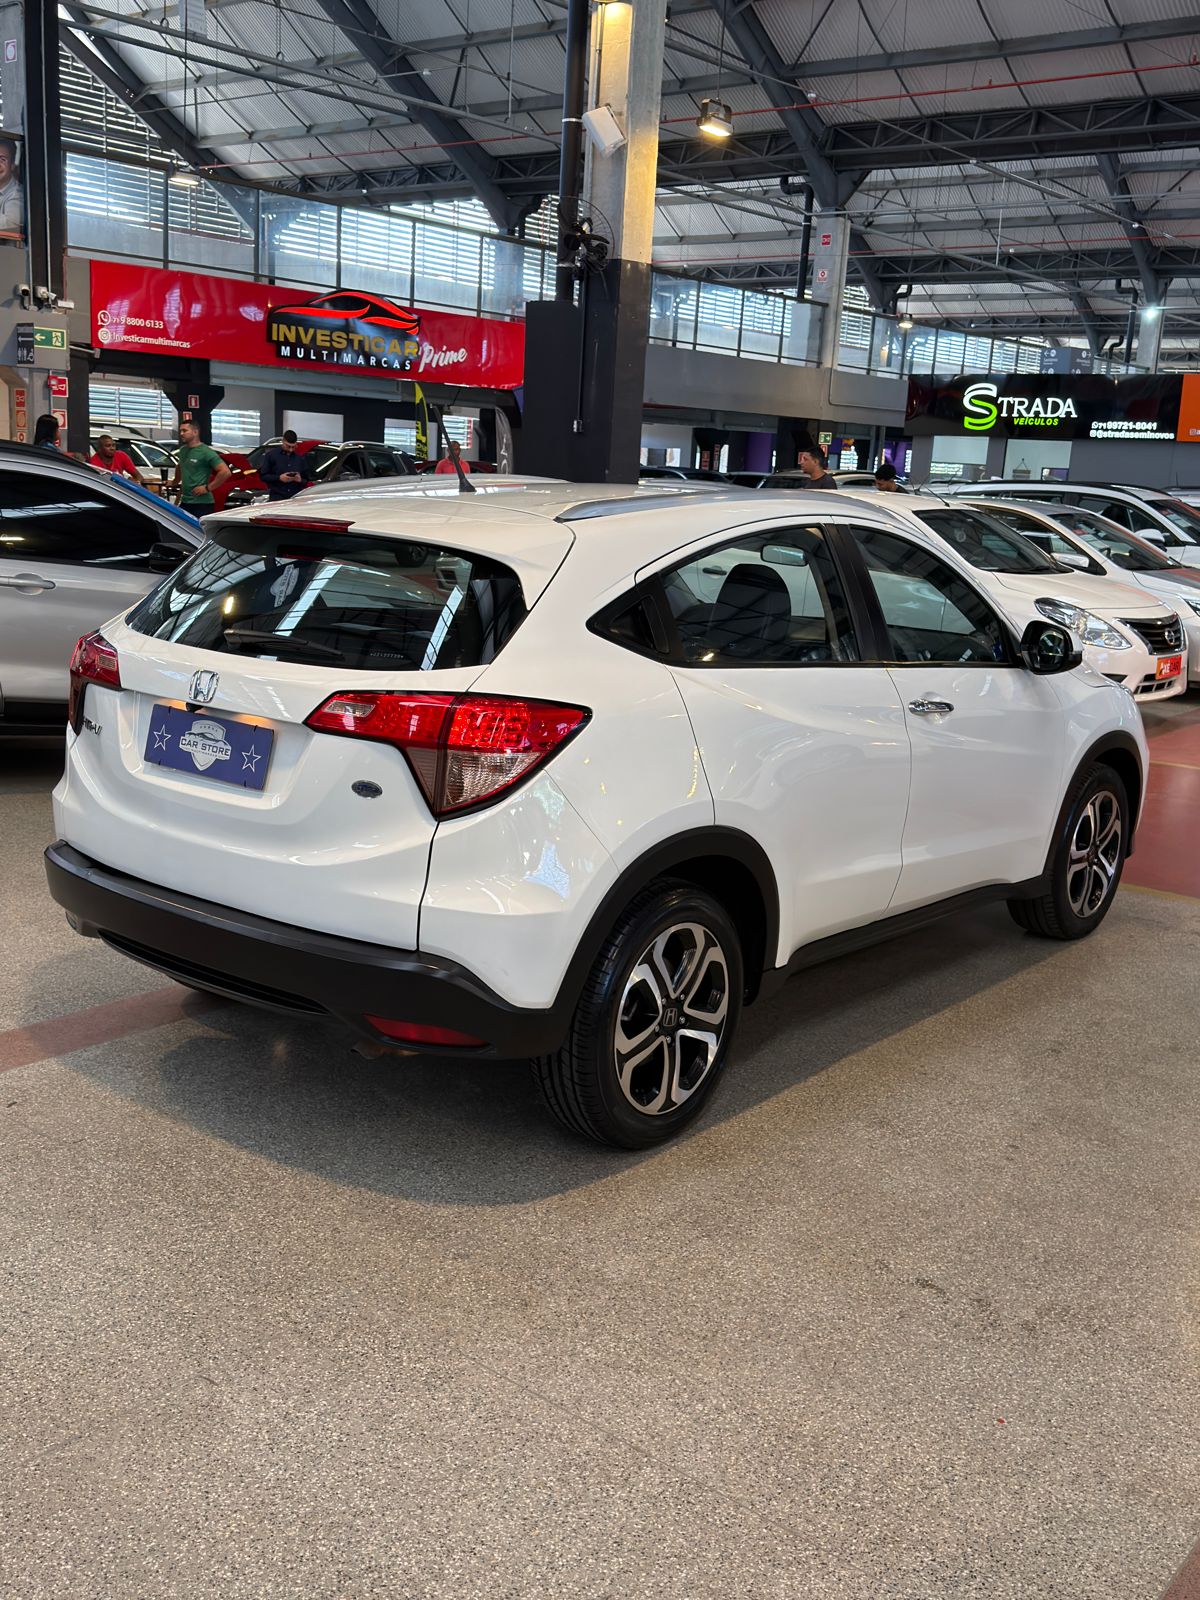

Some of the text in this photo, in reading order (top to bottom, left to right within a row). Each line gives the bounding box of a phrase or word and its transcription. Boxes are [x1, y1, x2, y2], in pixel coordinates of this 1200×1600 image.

[126, 317, 145, 327] 8800
[145, 320, 164, 329] 6133
[271, 322, 419, 357] INVESTICAR
[280, 345, 411, 371] MULTIMARCAS
[418, 341, 468, 373] Prime
[962, 382, 1078, 431] STRADA
[1013, 417, 1059, 426] VEÍCULOS
[180, 738, 199, 748] CAR
[201, 742, 230, 756] STORE
